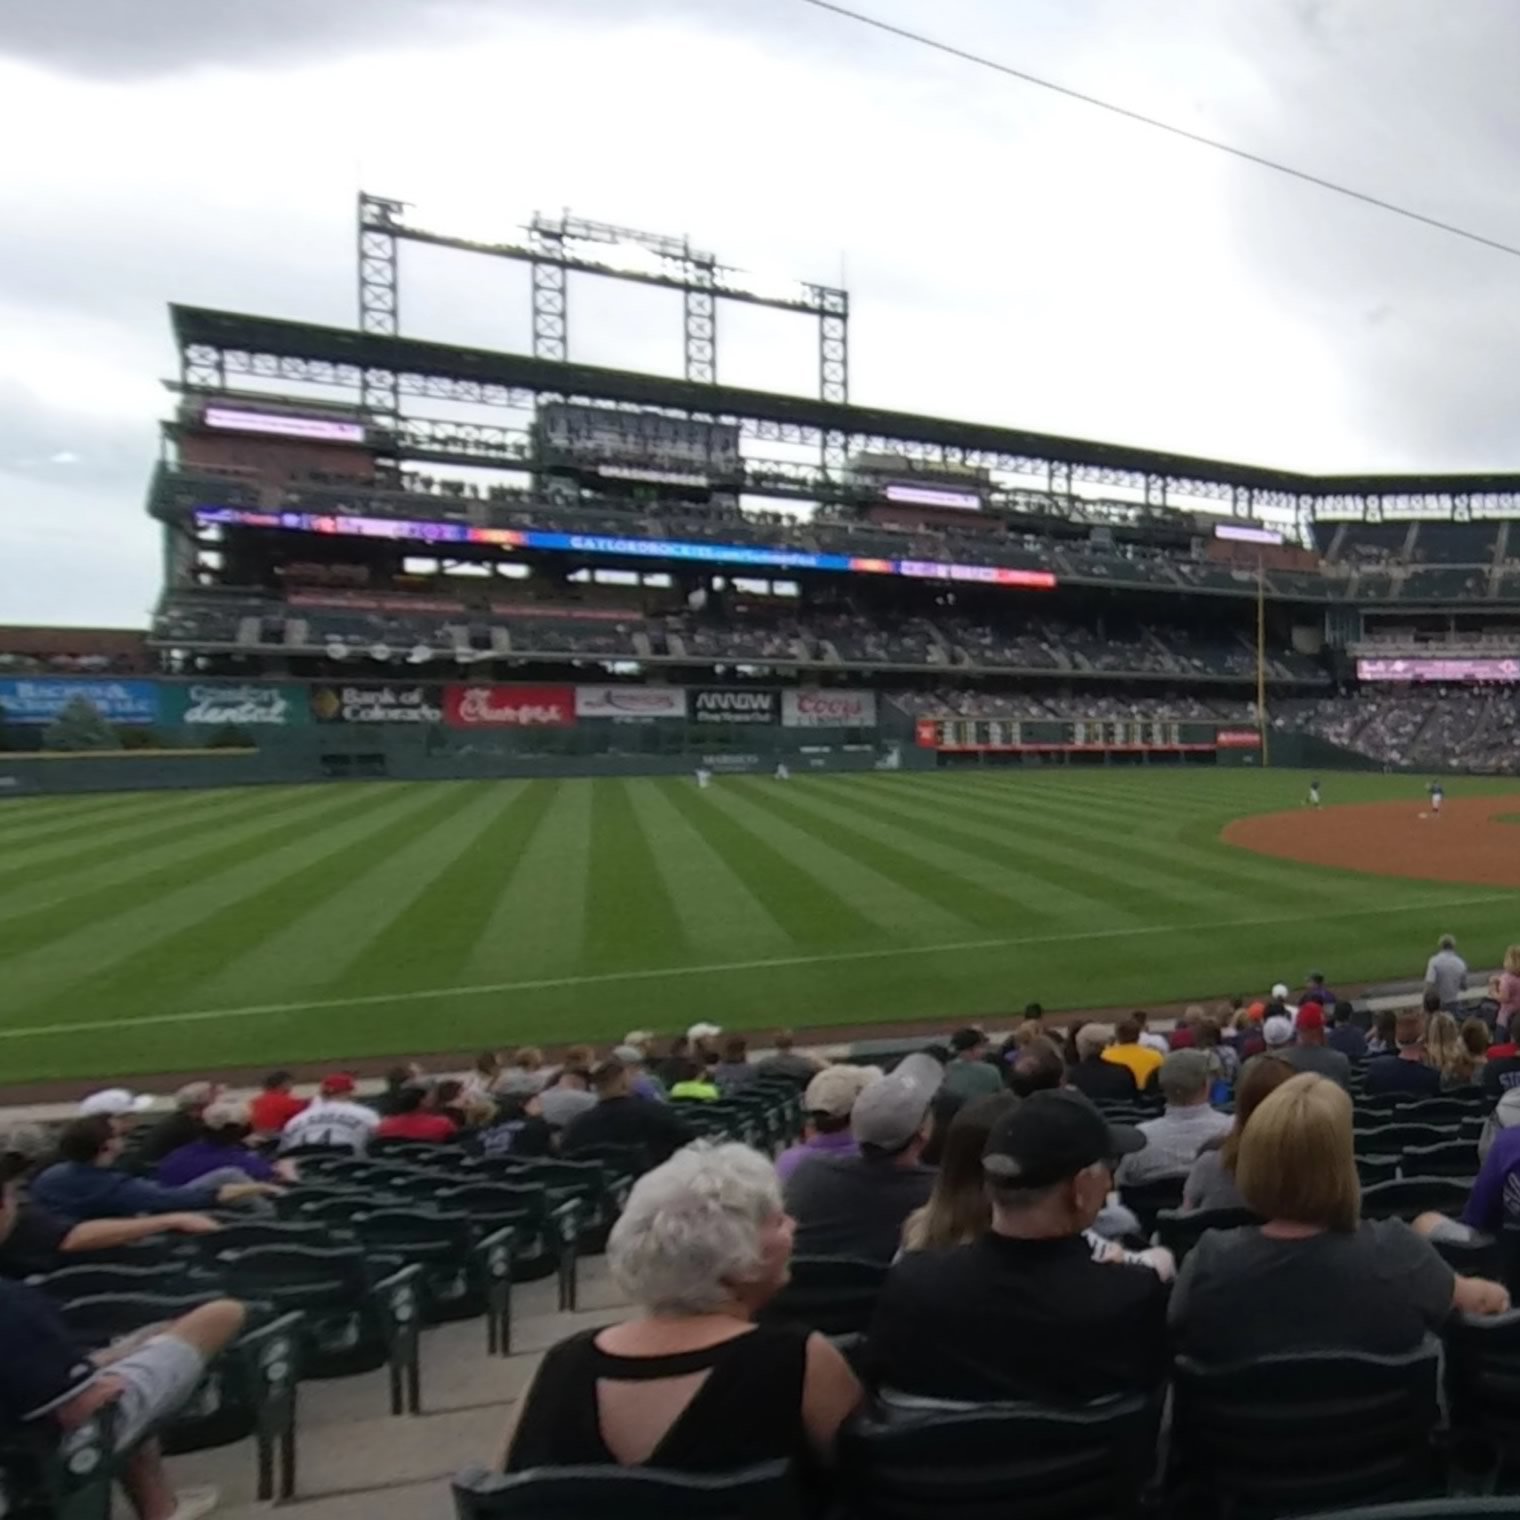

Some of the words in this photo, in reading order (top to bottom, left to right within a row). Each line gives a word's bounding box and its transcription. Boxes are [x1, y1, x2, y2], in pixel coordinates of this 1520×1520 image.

[343, 688, 401, 705] Bank
[403, 688, 424, 705] of
[696, 692, 772, 709] ARROW
[796, 692, 864, 716] Coors
[184, 697, 288, 724] dental
[343, 704, 442, 722] Colorado
